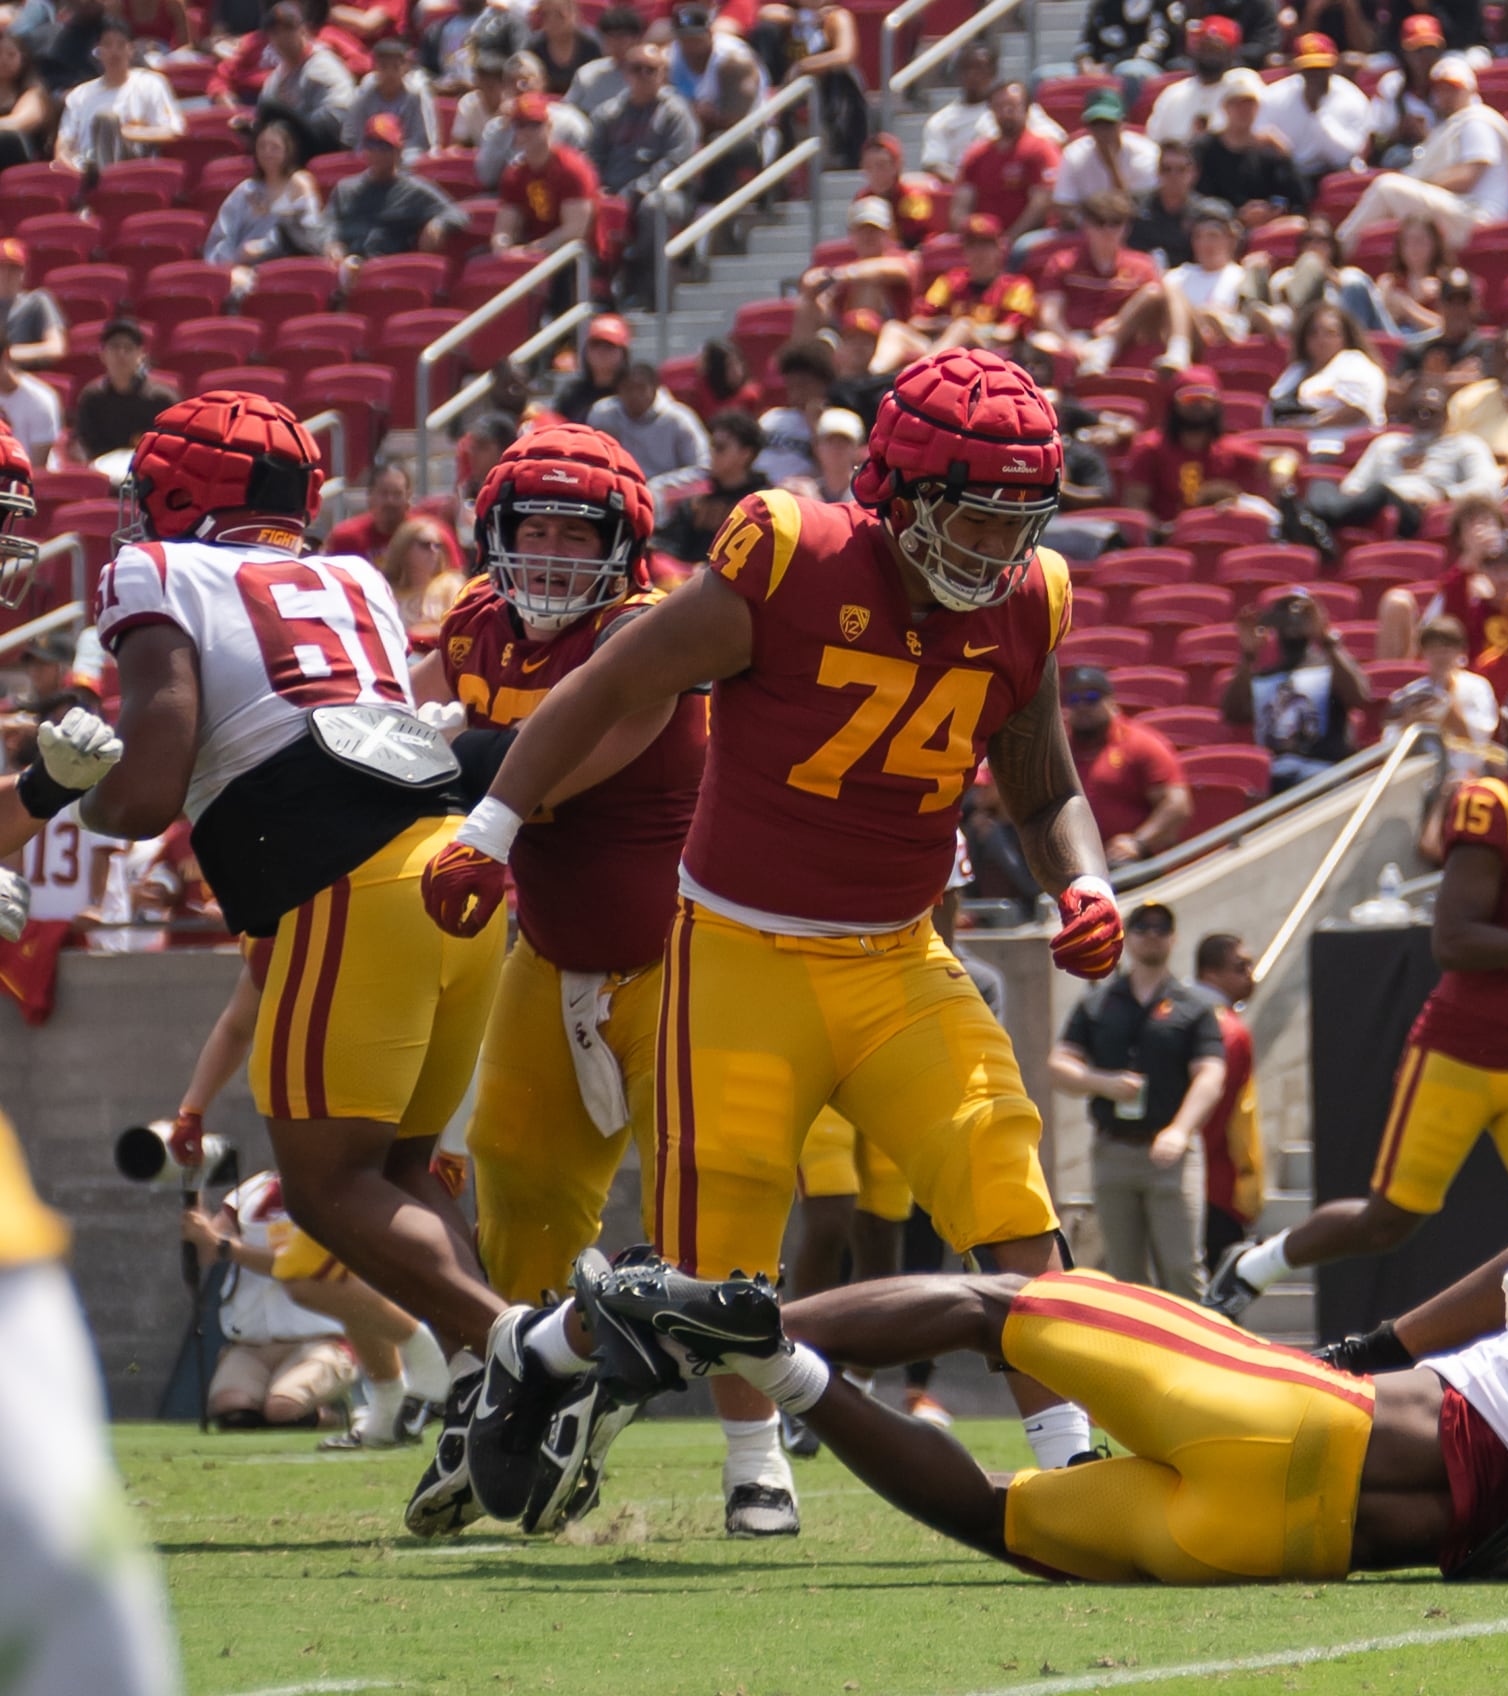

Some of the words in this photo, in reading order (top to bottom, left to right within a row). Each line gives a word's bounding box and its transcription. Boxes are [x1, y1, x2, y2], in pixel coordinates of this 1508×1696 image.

[256, 529, 301, 547] FIGHT
[235, 560, 408, 707] 61
[786, 645, 994, 813] 74
[1453, 792, 1496, 835] 15
[30, 822, 79, 887] 13
